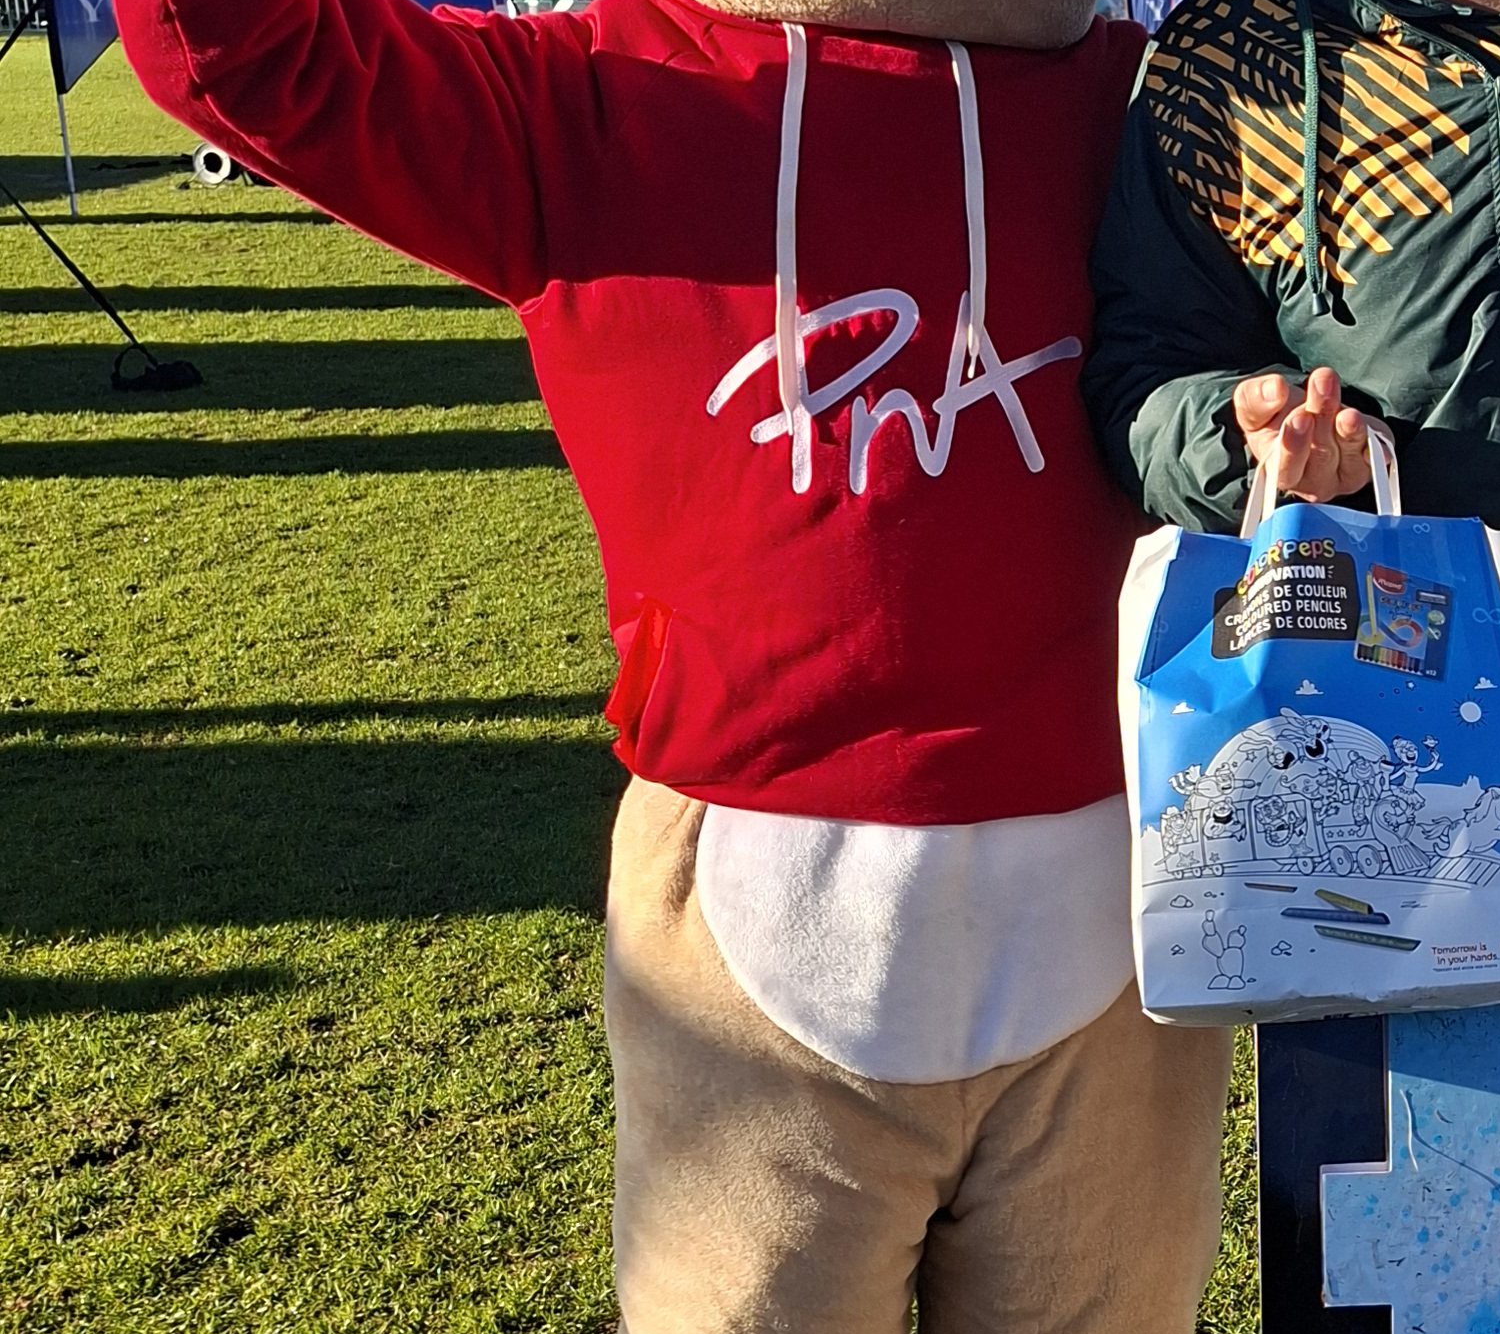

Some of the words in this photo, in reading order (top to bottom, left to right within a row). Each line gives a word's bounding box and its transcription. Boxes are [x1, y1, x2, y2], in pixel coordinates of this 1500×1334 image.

[1273, 584, 1292, 598] DE
[1296, 584, 1348, 599] COULEUR
[1296, 600, 1342, 614] PENCILS
[1275, 616, 1294, 629] DE
[1297, 617, 1348, 630] COLORES
[1432, 945, 1477, 955] Tomorrow
[1479, 942, 1487, 952] is
[1448, 955, 1468, 966] your
